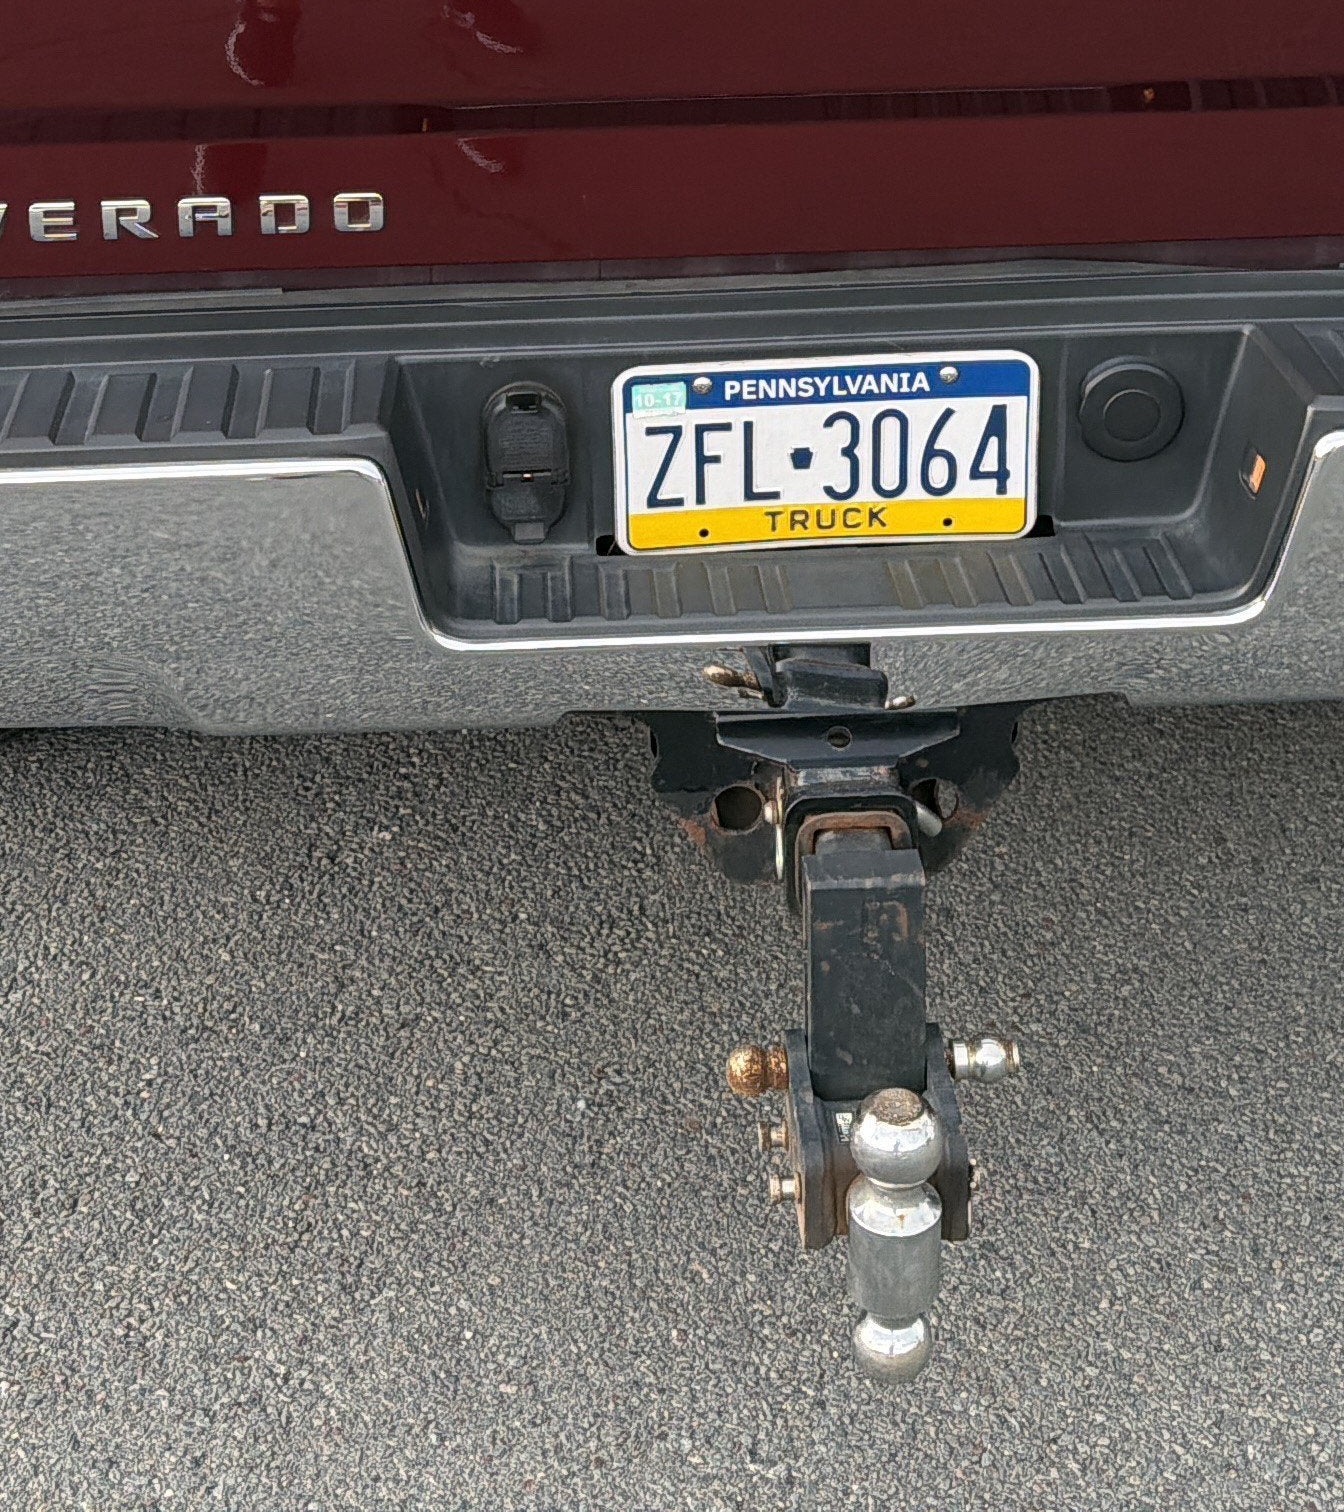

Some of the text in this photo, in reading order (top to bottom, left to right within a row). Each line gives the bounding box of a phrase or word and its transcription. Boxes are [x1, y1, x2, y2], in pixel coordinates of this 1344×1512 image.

[636, 391, 682, 407] 10-17
[724, 372, 930, 401] PENNSYLVANIA
[764, 506, 888, 532] TRUCK
